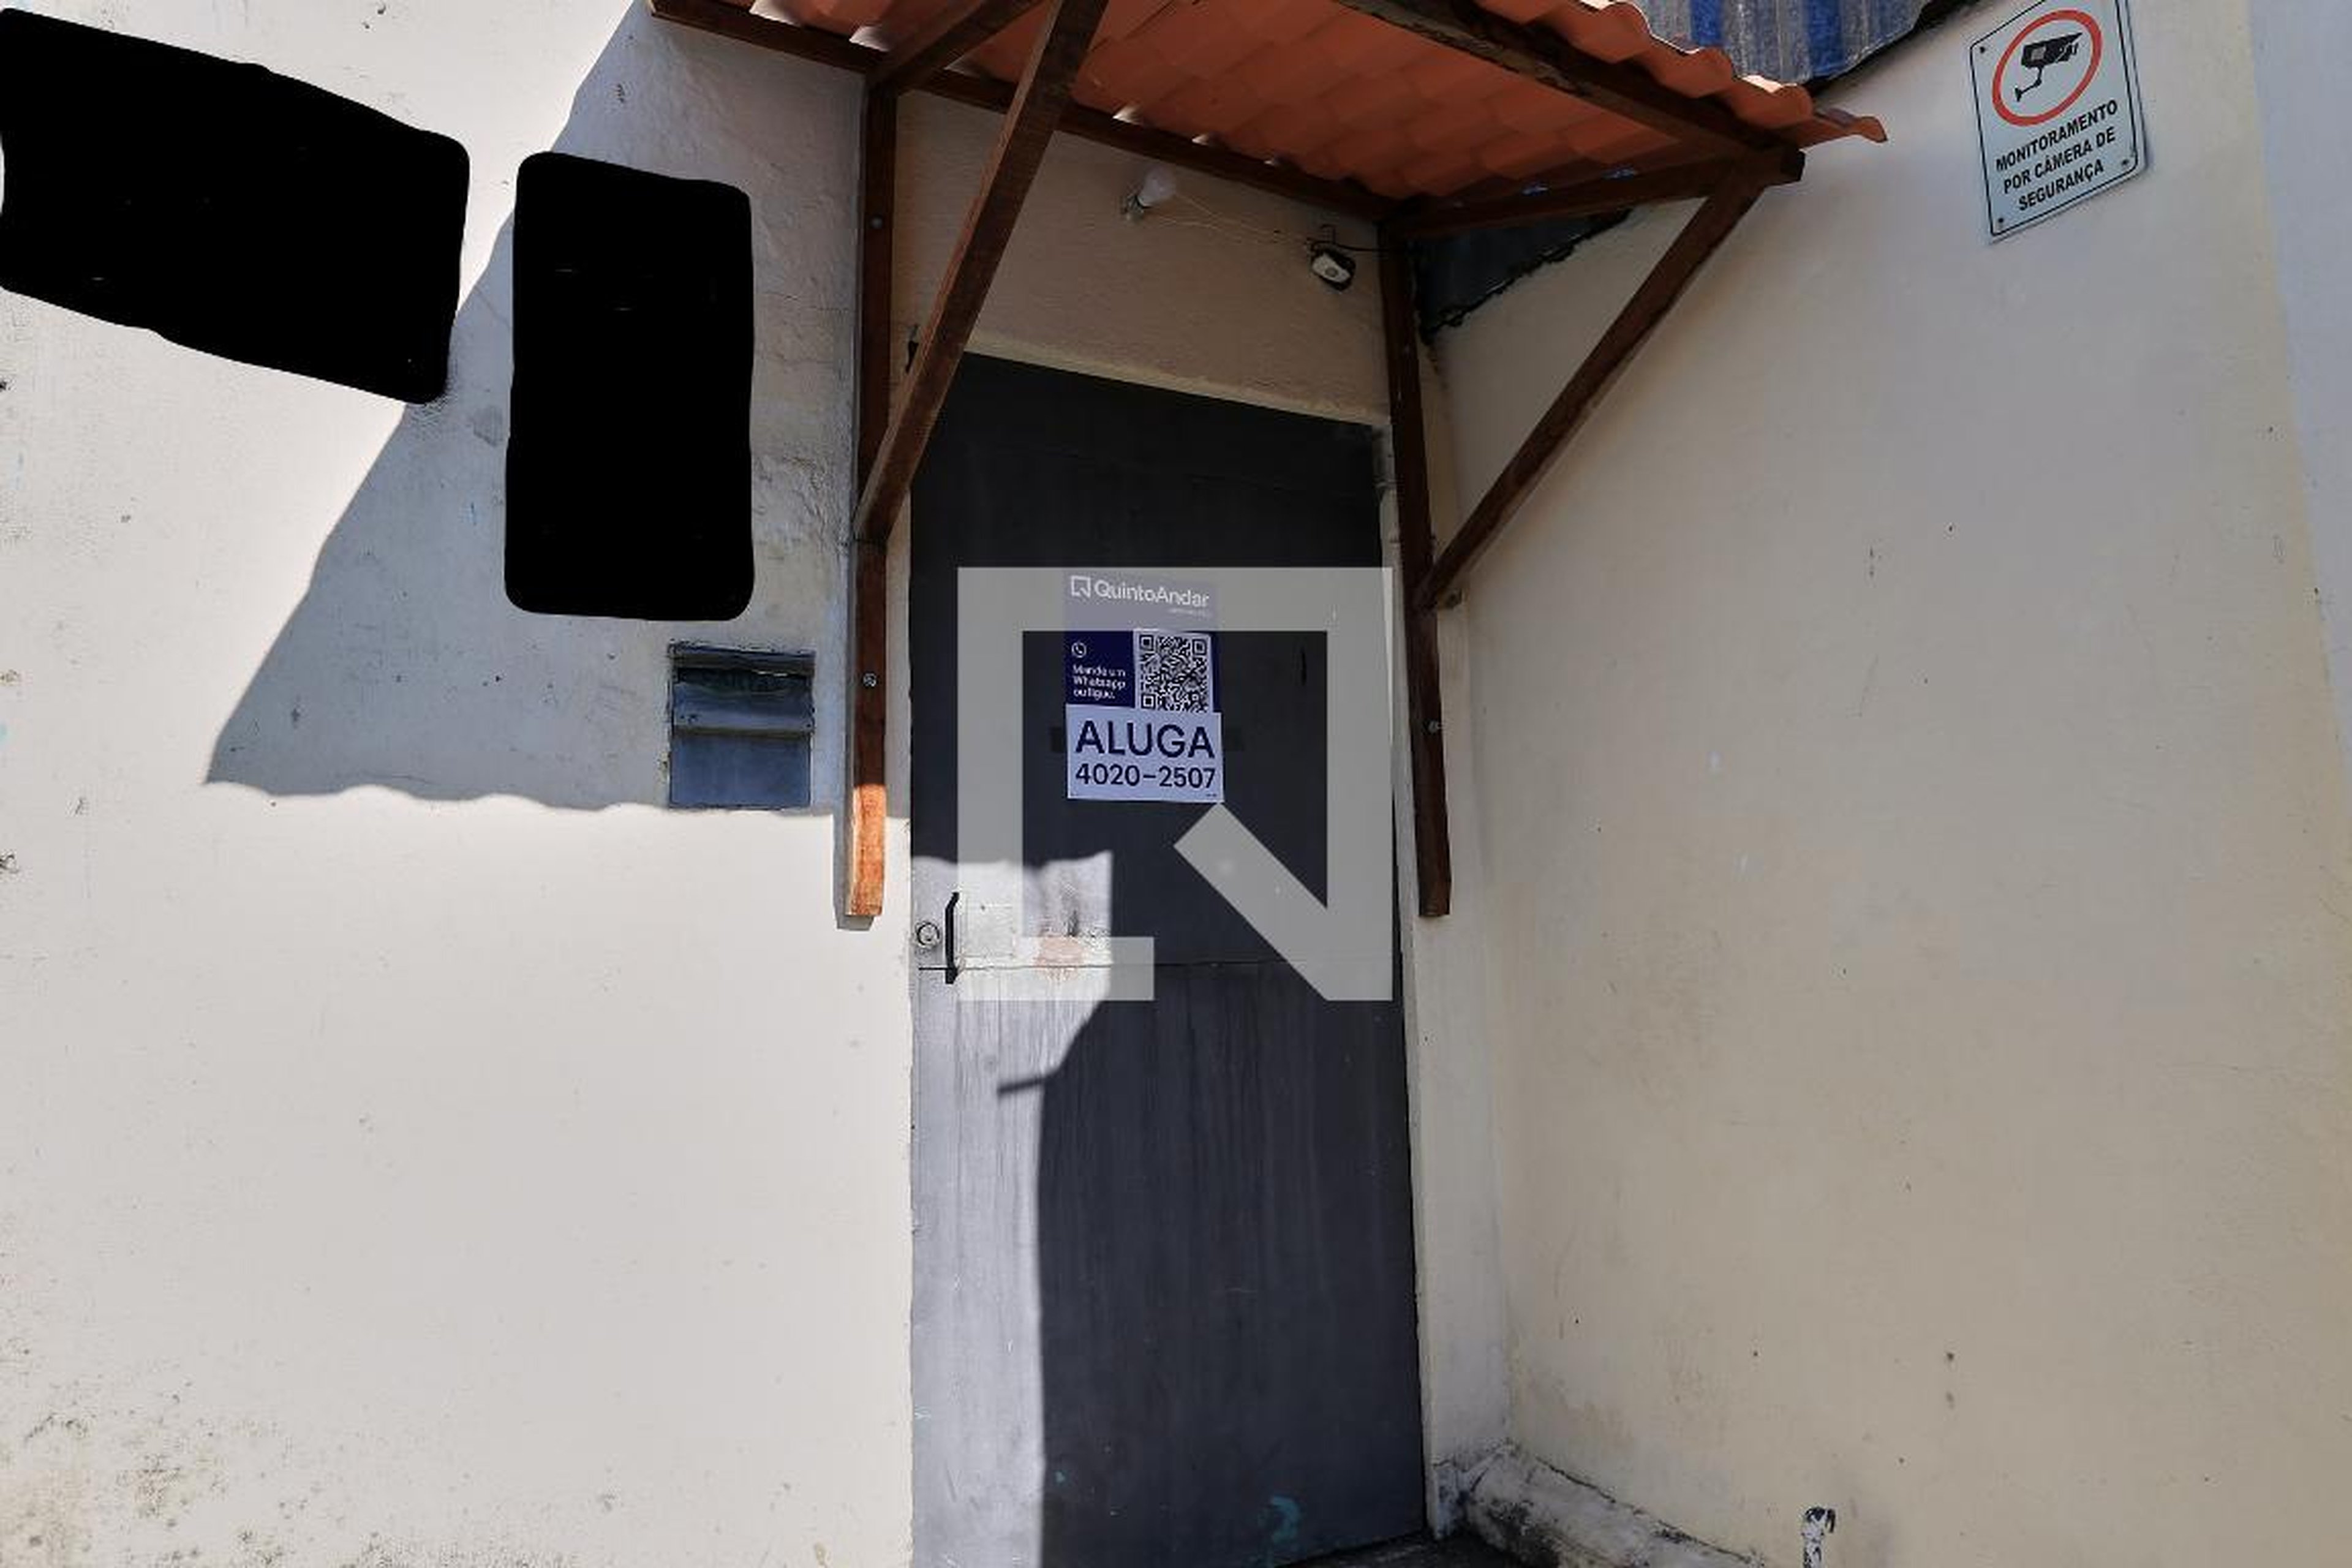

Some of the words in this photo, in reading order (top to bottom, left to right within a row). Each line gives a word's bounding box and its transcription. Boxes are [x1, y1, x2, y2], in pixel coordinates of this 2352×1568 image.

[1996, 99, 2118, 172] MONITORAMENTO
[2003, 171, 2031, 194] POR
[2035, 139, 2093, 178] CÂMERA
[2096, 126, 2116, 148] DE
[2018, 159, 2105, 211] SEGURANÇA
[1094, 580, 1210, 607] QuintoAndar
[1076, 720, 1215, 758] ALUGA
[1076, 763, 1216, 788] 4020-2507
